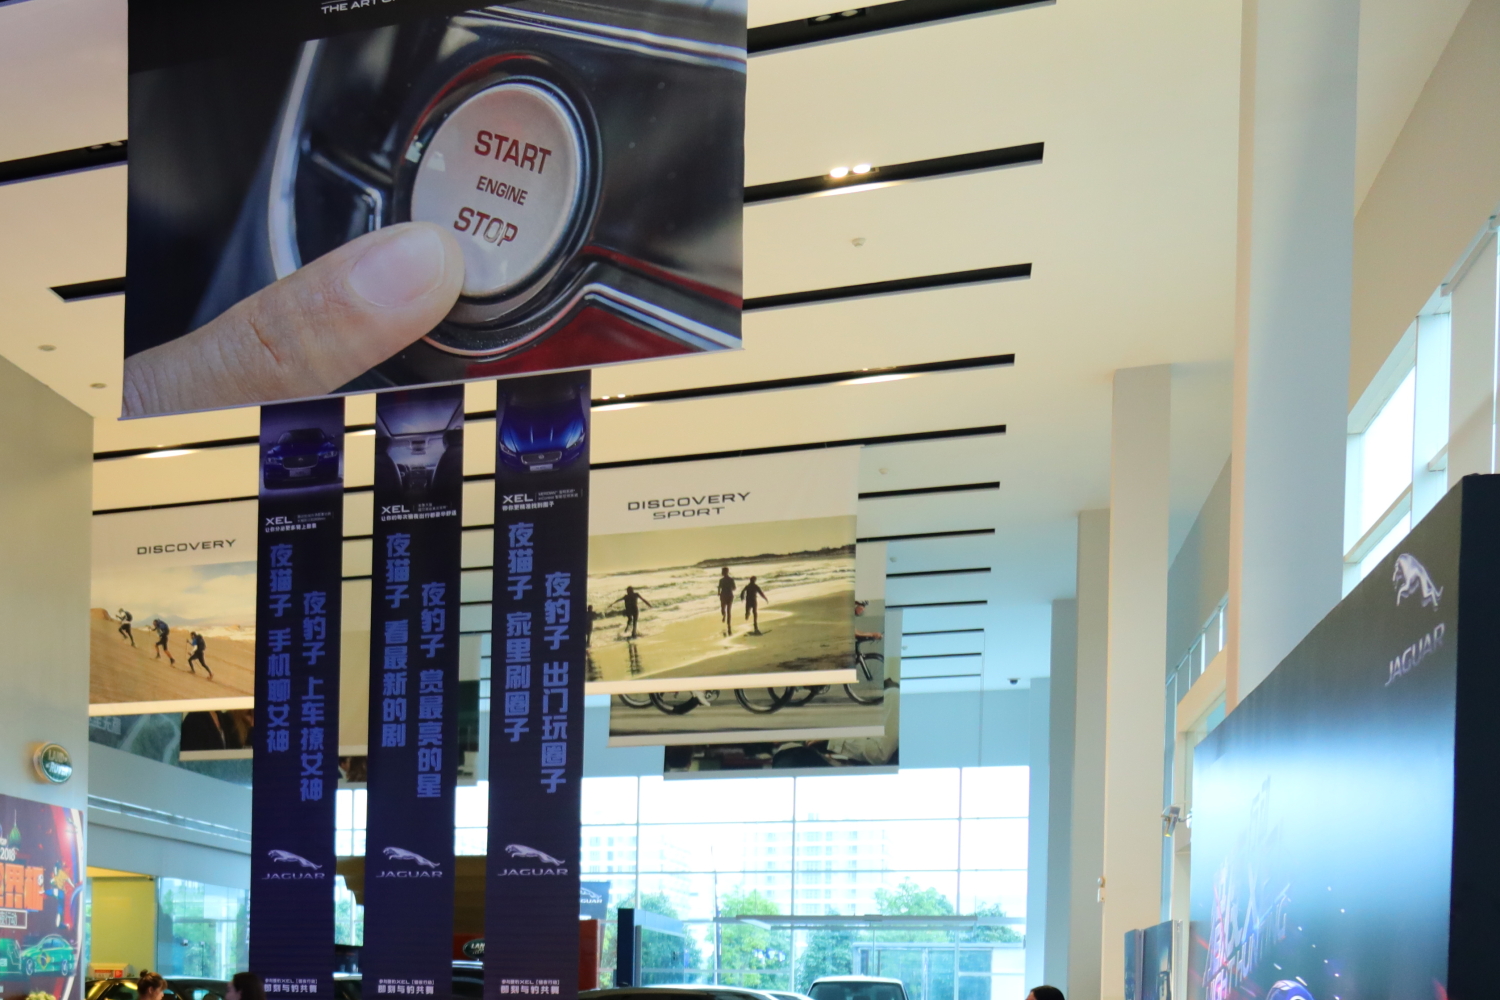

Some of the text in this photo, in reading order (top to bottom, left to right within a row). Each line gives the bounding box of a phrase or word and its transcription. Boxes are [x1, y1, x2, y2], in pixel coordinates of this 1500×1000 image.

[321, 3, 349, 15] THE
[473, 130, 553, 176] START
[475, 174, 529, 207] ENGINE
[452, 206, 519, 249] STOP
[502, 492, 534, 505] XEL
[627, 491, 752, 512] DISCOVERY
[381, 504, 411, 515] XEL
[652, 506, 726, 521] SPORT
[265, 515, 293, 527] XEL
[136, 538, 237, 556] DISCOVERY
[381, 532, 411, 748] 夜猫子 看最新的剧
[504, 521, 534, 743] 夜猫子 家里刷圈子
[266, 543, 294, 754] 夜猫子 手机聊女神
[1384, 622, 1446, 687] JAGUAR
[417, 580, 446, 798] 夜豹子 赏最亮的星
[540, 570, 571, 794] 夜豹子 出门玩圈子
[300, 589, 327, 802] 夜豹子 上车撩女神
[0, 847, 16, 862] 2018
[261, 872, 326, 880] JAGUAR
[375, 871, 443, 879] JAGUAR
[496, 868, 570, 877] JAGUAR
